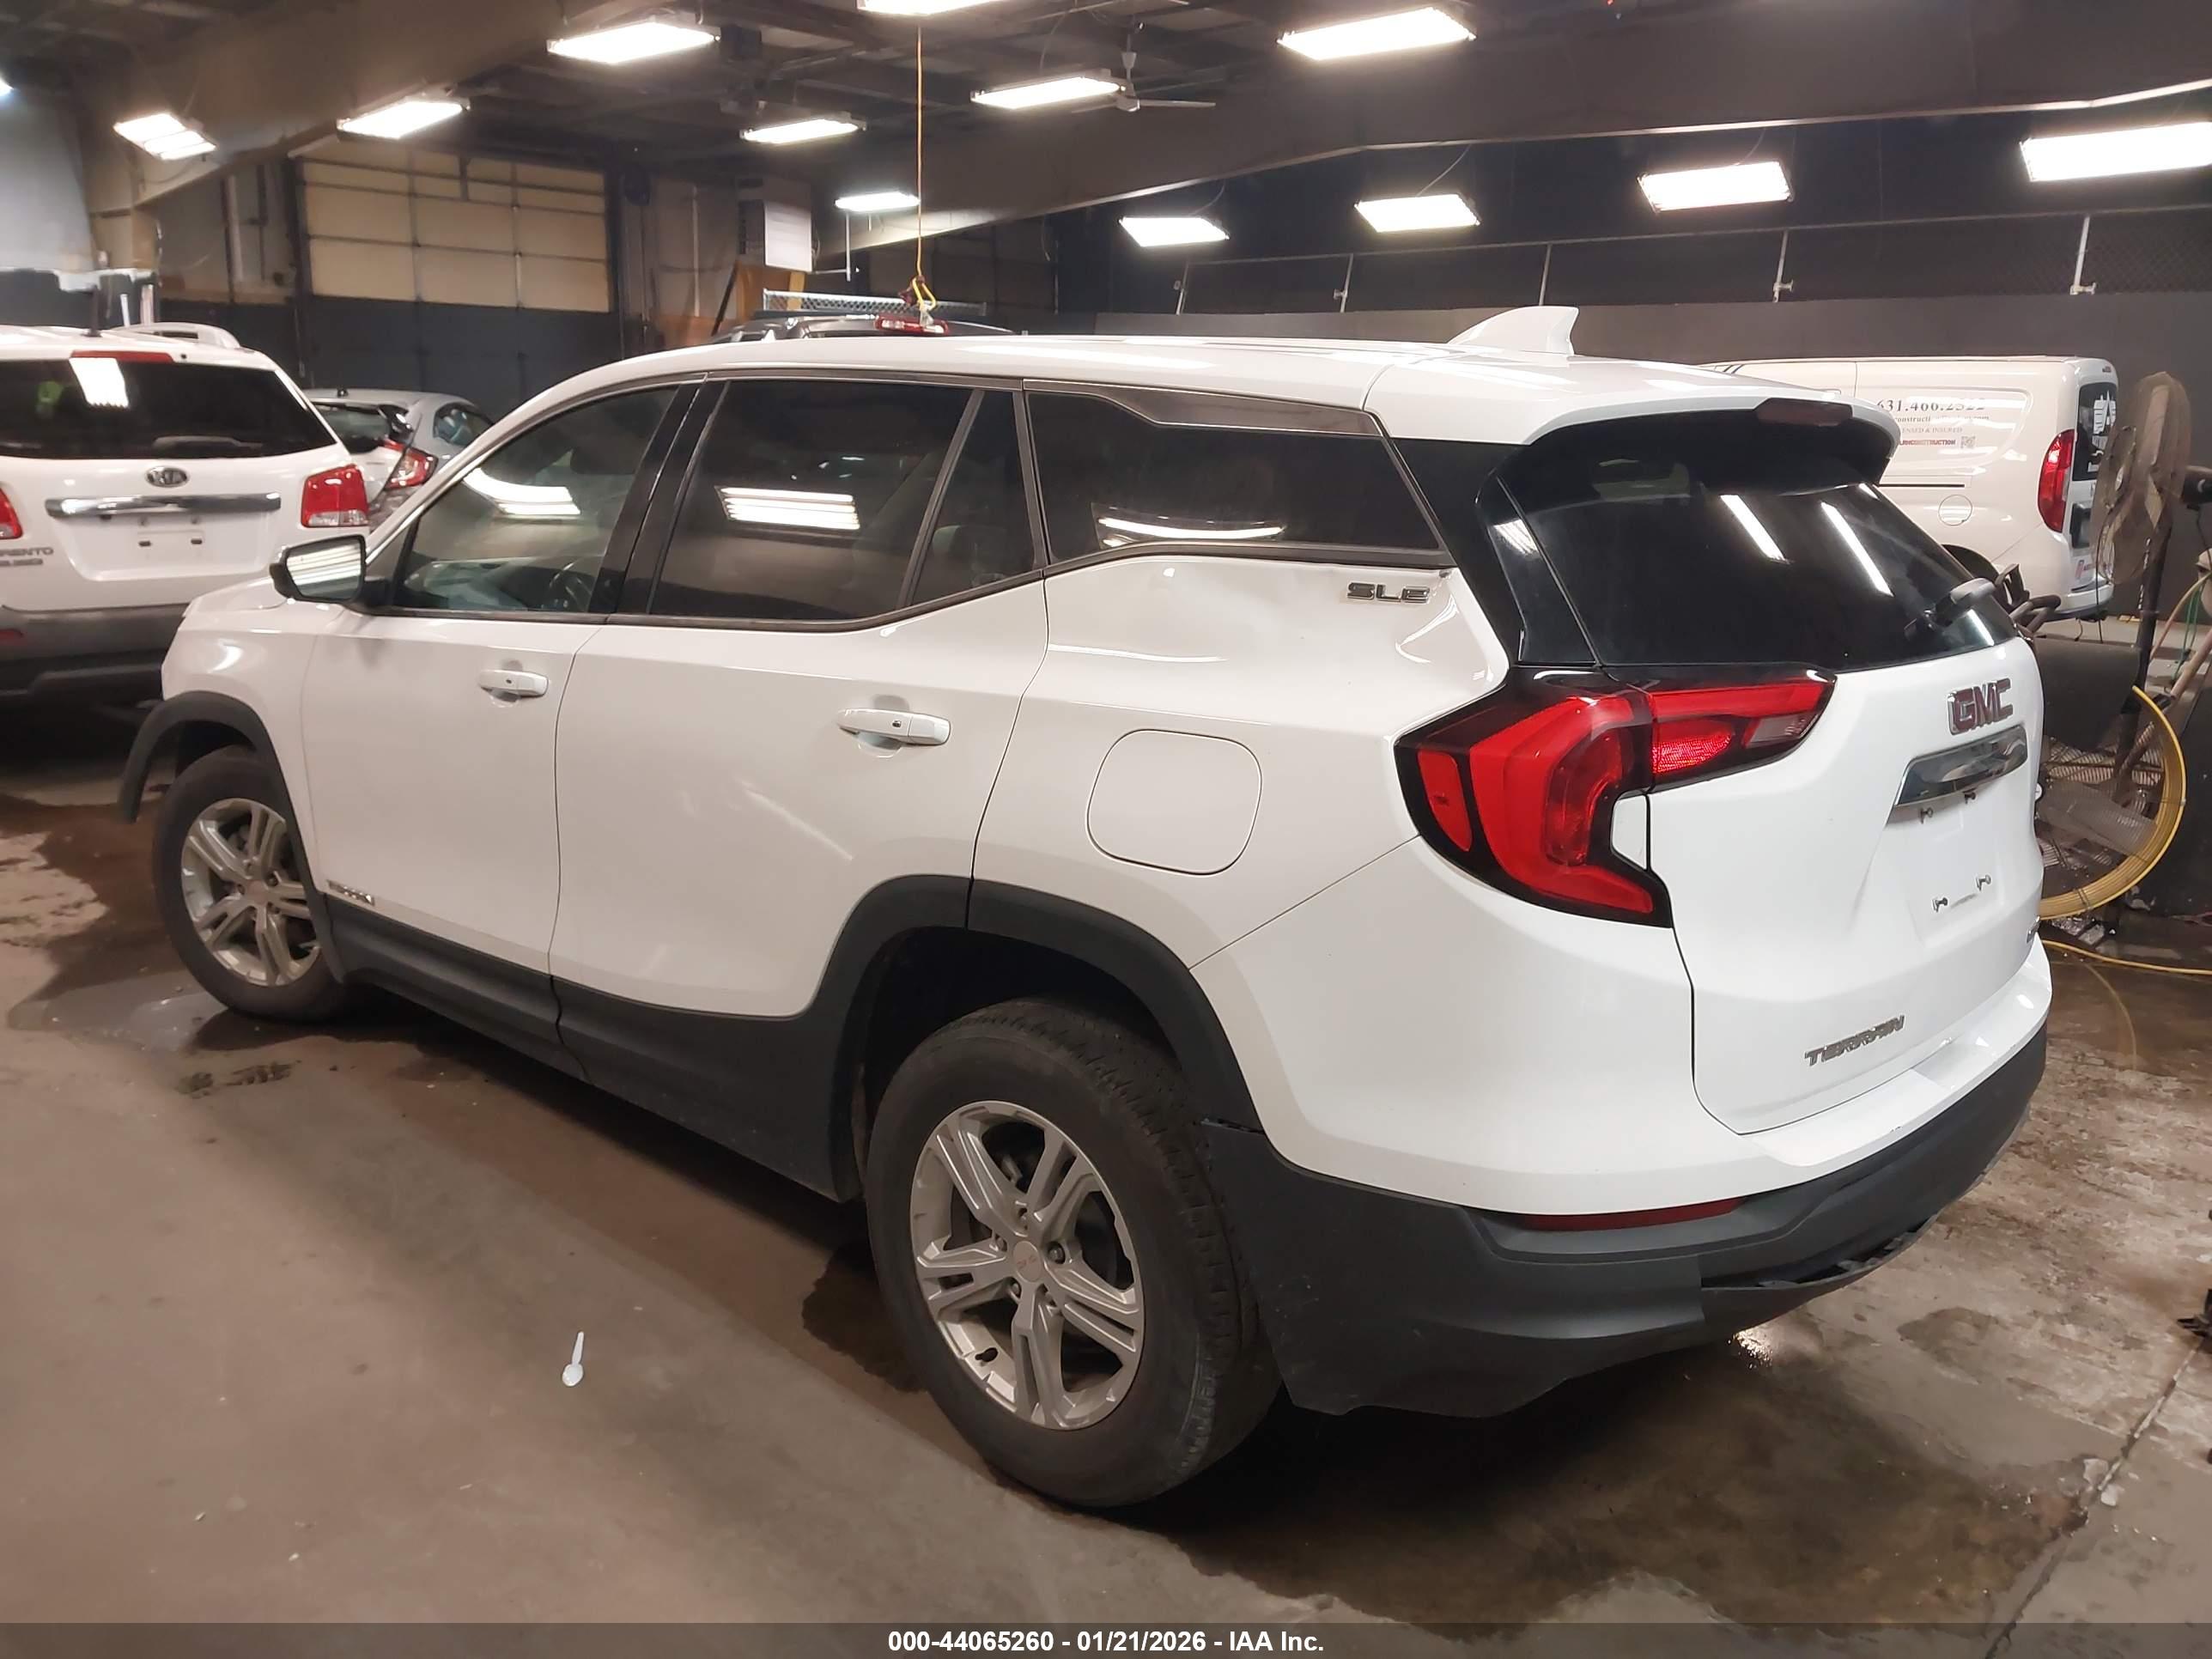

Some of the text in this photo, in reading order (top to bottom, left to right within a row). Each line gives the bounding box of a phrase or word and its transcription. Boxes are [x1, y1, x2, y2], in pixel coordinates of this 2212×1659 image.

[1346, 582, 1431, 604] SLE
[1947, 677, 2014, 736] GMC
[1804, 1014, 1905, 1066] TERRAIN
